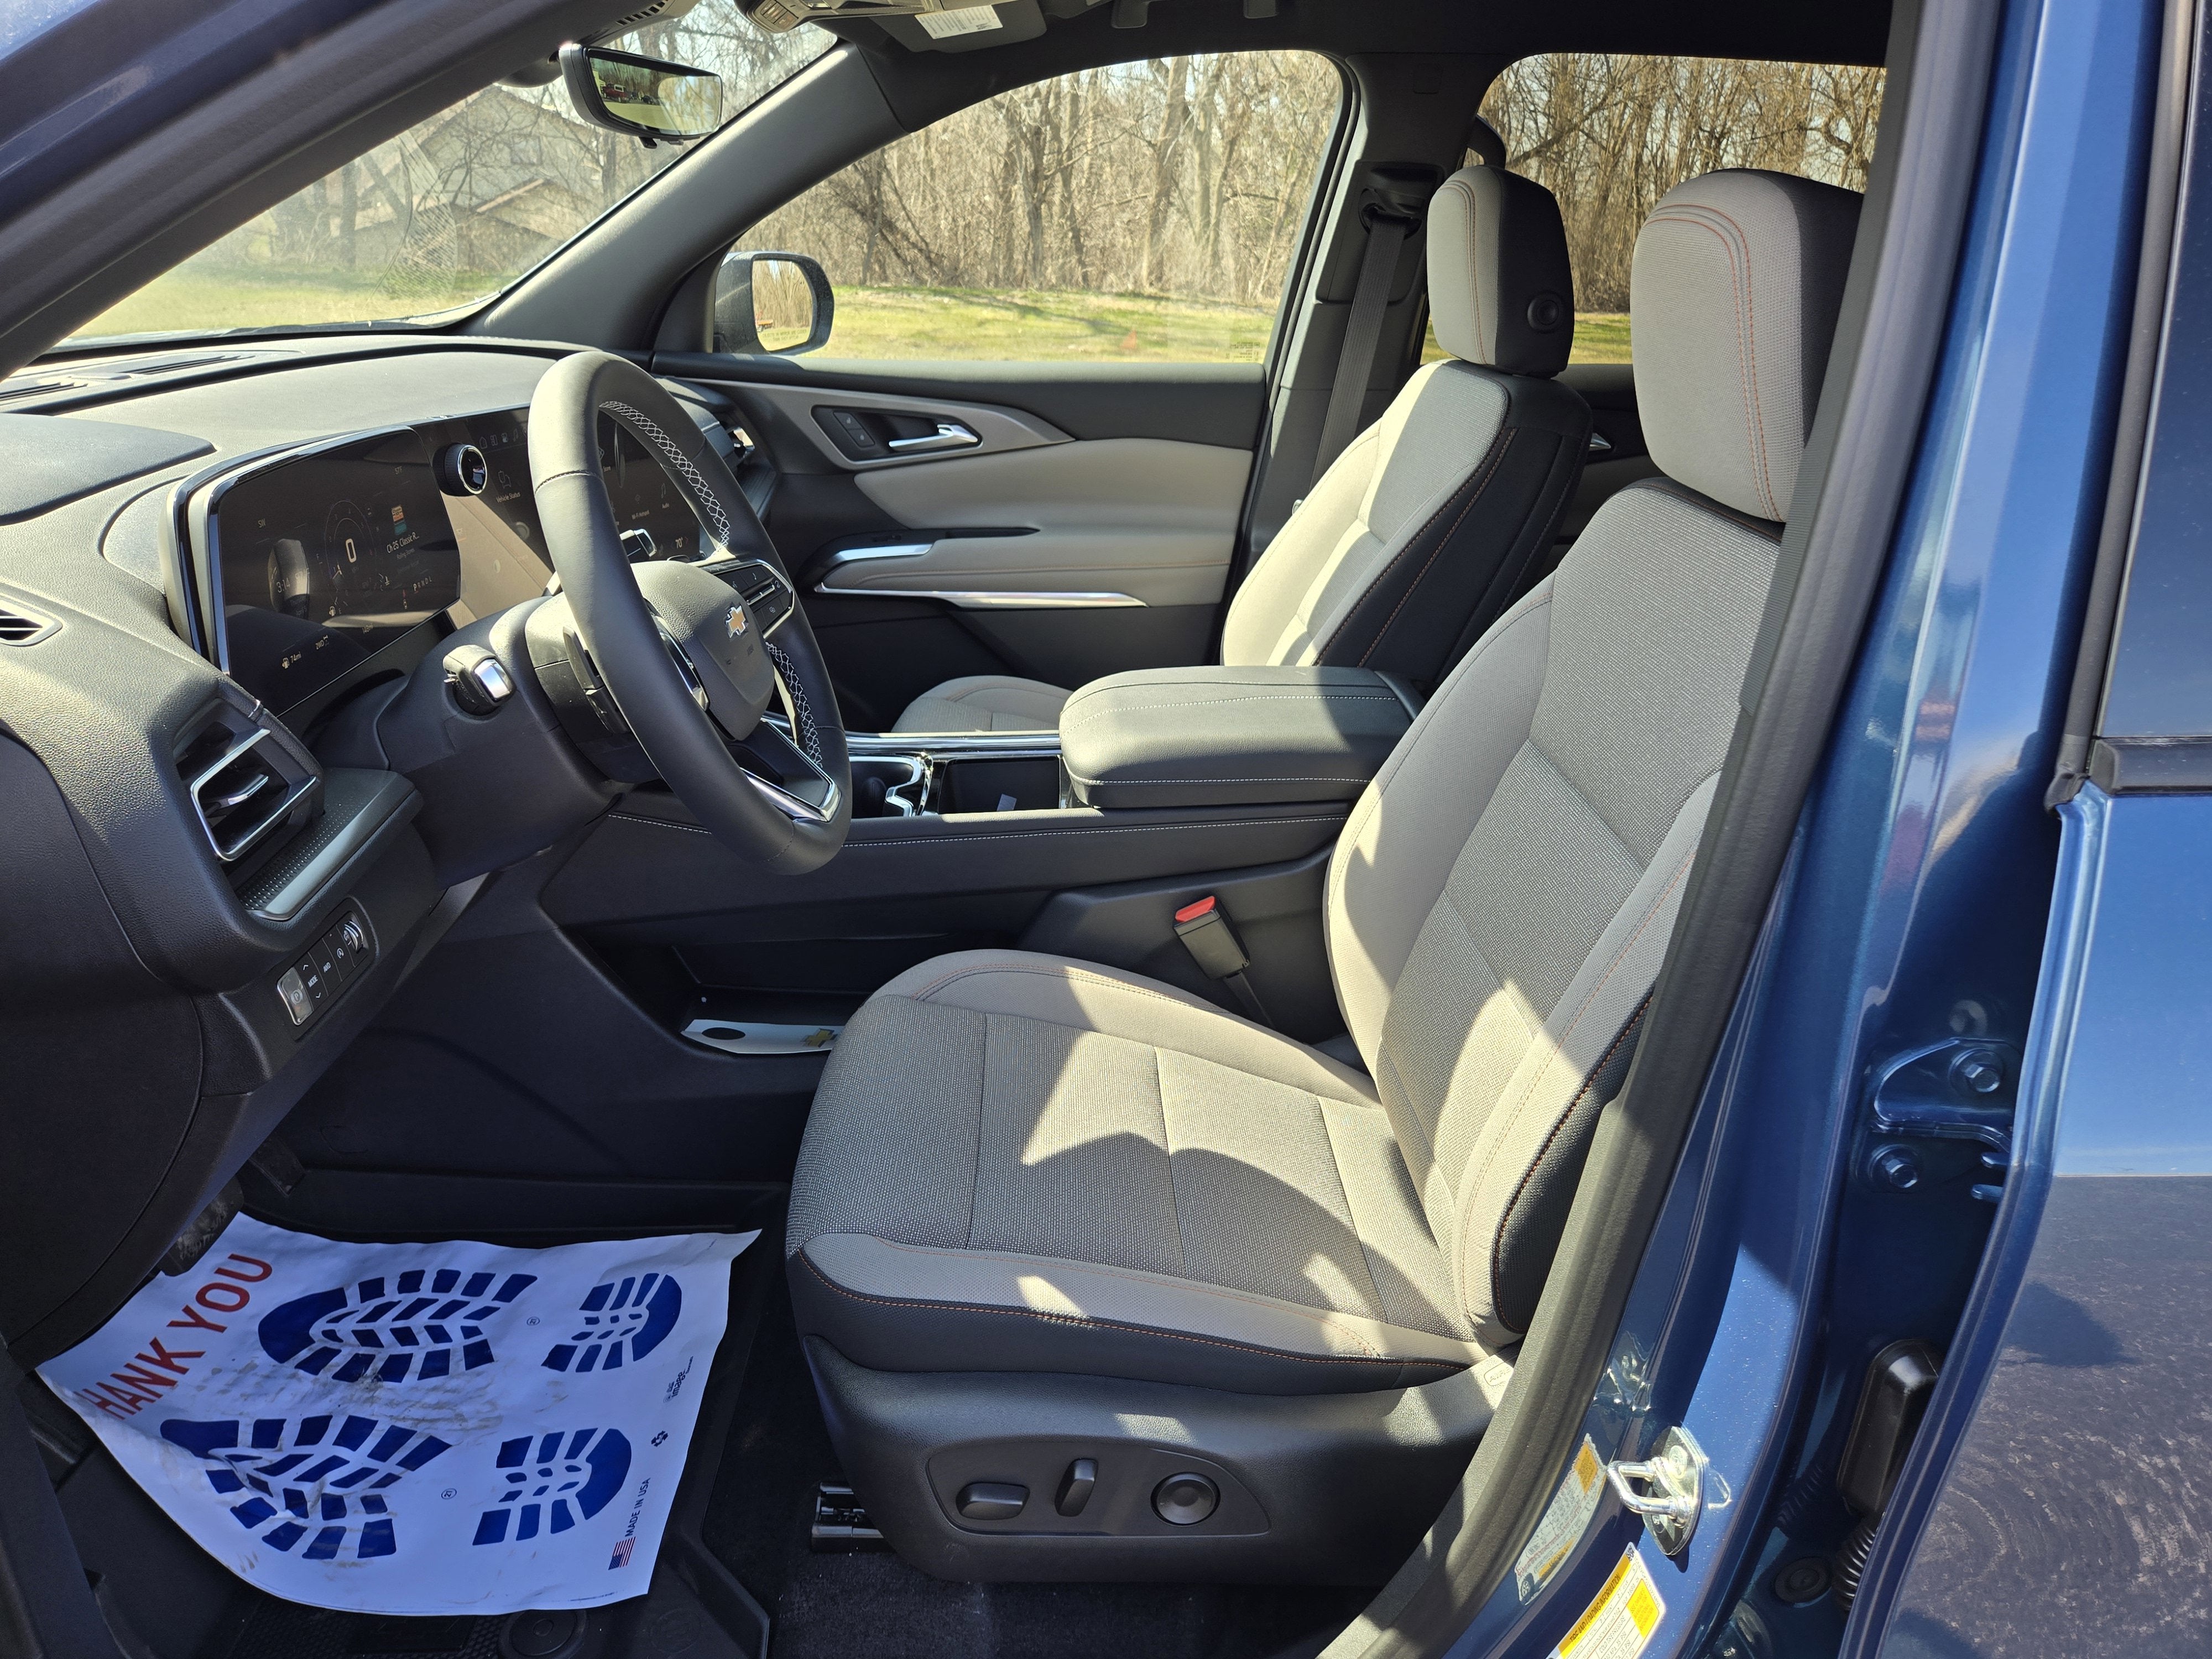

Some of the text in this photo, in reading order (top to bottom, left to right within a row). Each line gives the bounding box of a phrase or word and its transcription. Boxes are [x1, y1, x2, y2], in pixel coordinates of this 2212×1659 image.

[496, 492, 521, 503] Vehicle Status
[345, 538, 357, 563] 0
[387, 544, 393, 553] Ch
[393, 540, 399, 550] 25
[399, 534, 413, 547] Classic
[276, 577, 291, 593] 3:14
[290, 651, 302, 663] 74mi
[307, 975, 319, 988] MODE
[72, 1253, 273, 1421] HANK YOU
[625, 1477, 651, 1537] MADE IN USA
[1578, 1620, 1587, 1634] AND
[1585, 1601, 1601, 1625] LOADING
[1599, 1572, 1621, 1607] INFORMATION
